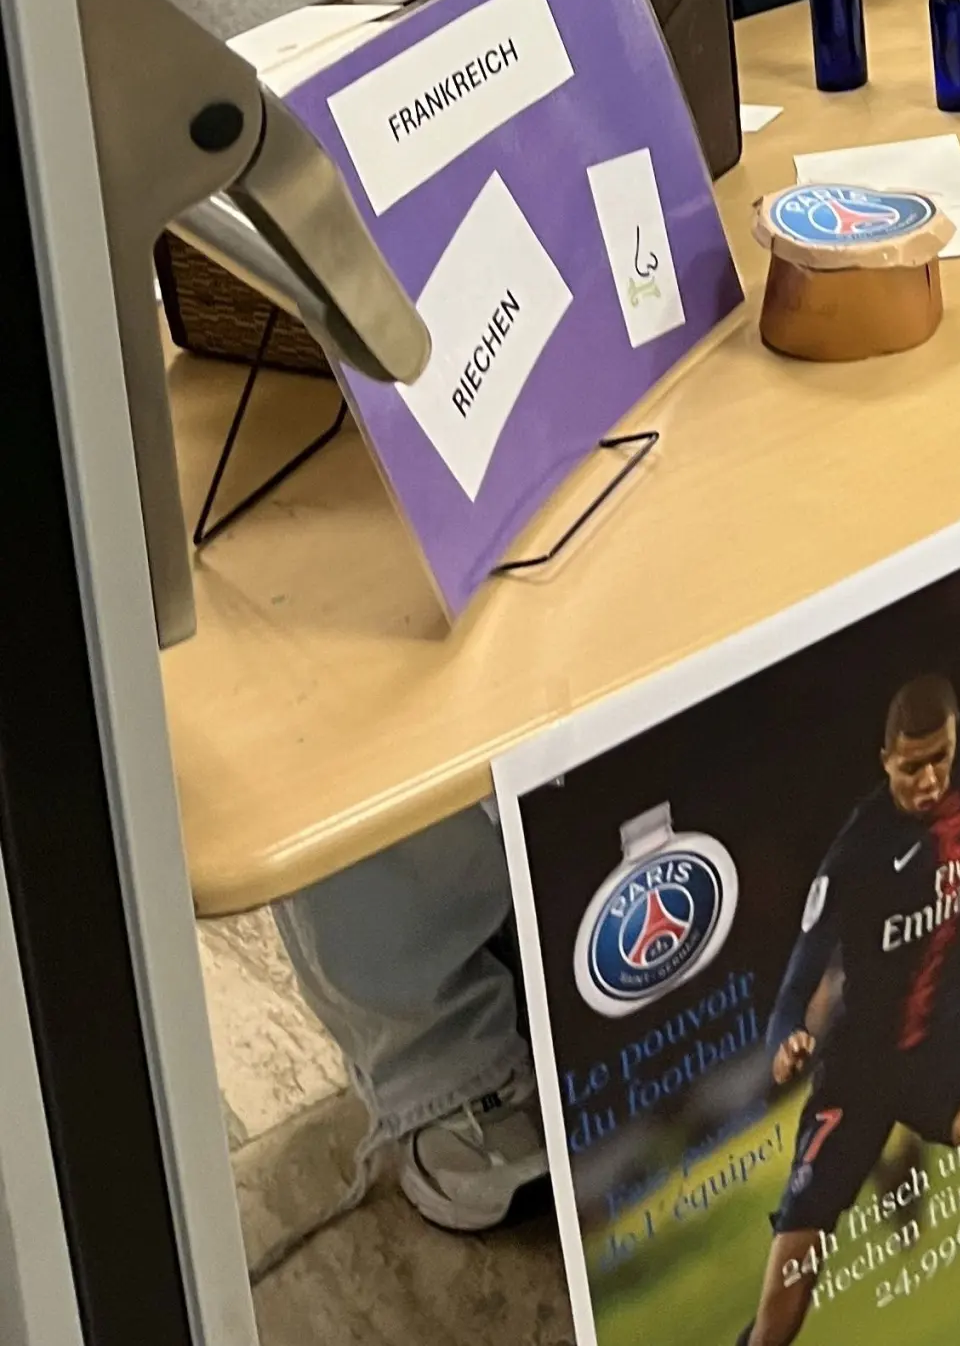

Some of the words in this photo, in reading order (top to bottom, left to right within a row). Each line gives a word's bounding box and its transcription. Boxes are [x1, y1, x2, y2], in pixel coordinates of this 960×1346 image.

[388, 38, 520, 143] FRANKREICH
[450, 289, 522, 419] RIECHEN
[610, 860, 693, 918] PARIS
[564, 1062, 610, 1105] Le
[620, 971, 755, 1081] pouvoir
[570, 1105, 616, 1154] du
[628, 1007, 760, 1117] football
[804, 1107, 843, 1165] 7
[780, 1229, 838, 1288] 24h
[848, 1166, 931, 1241] frisch
[810, 1217, 922, 1310] riechen
